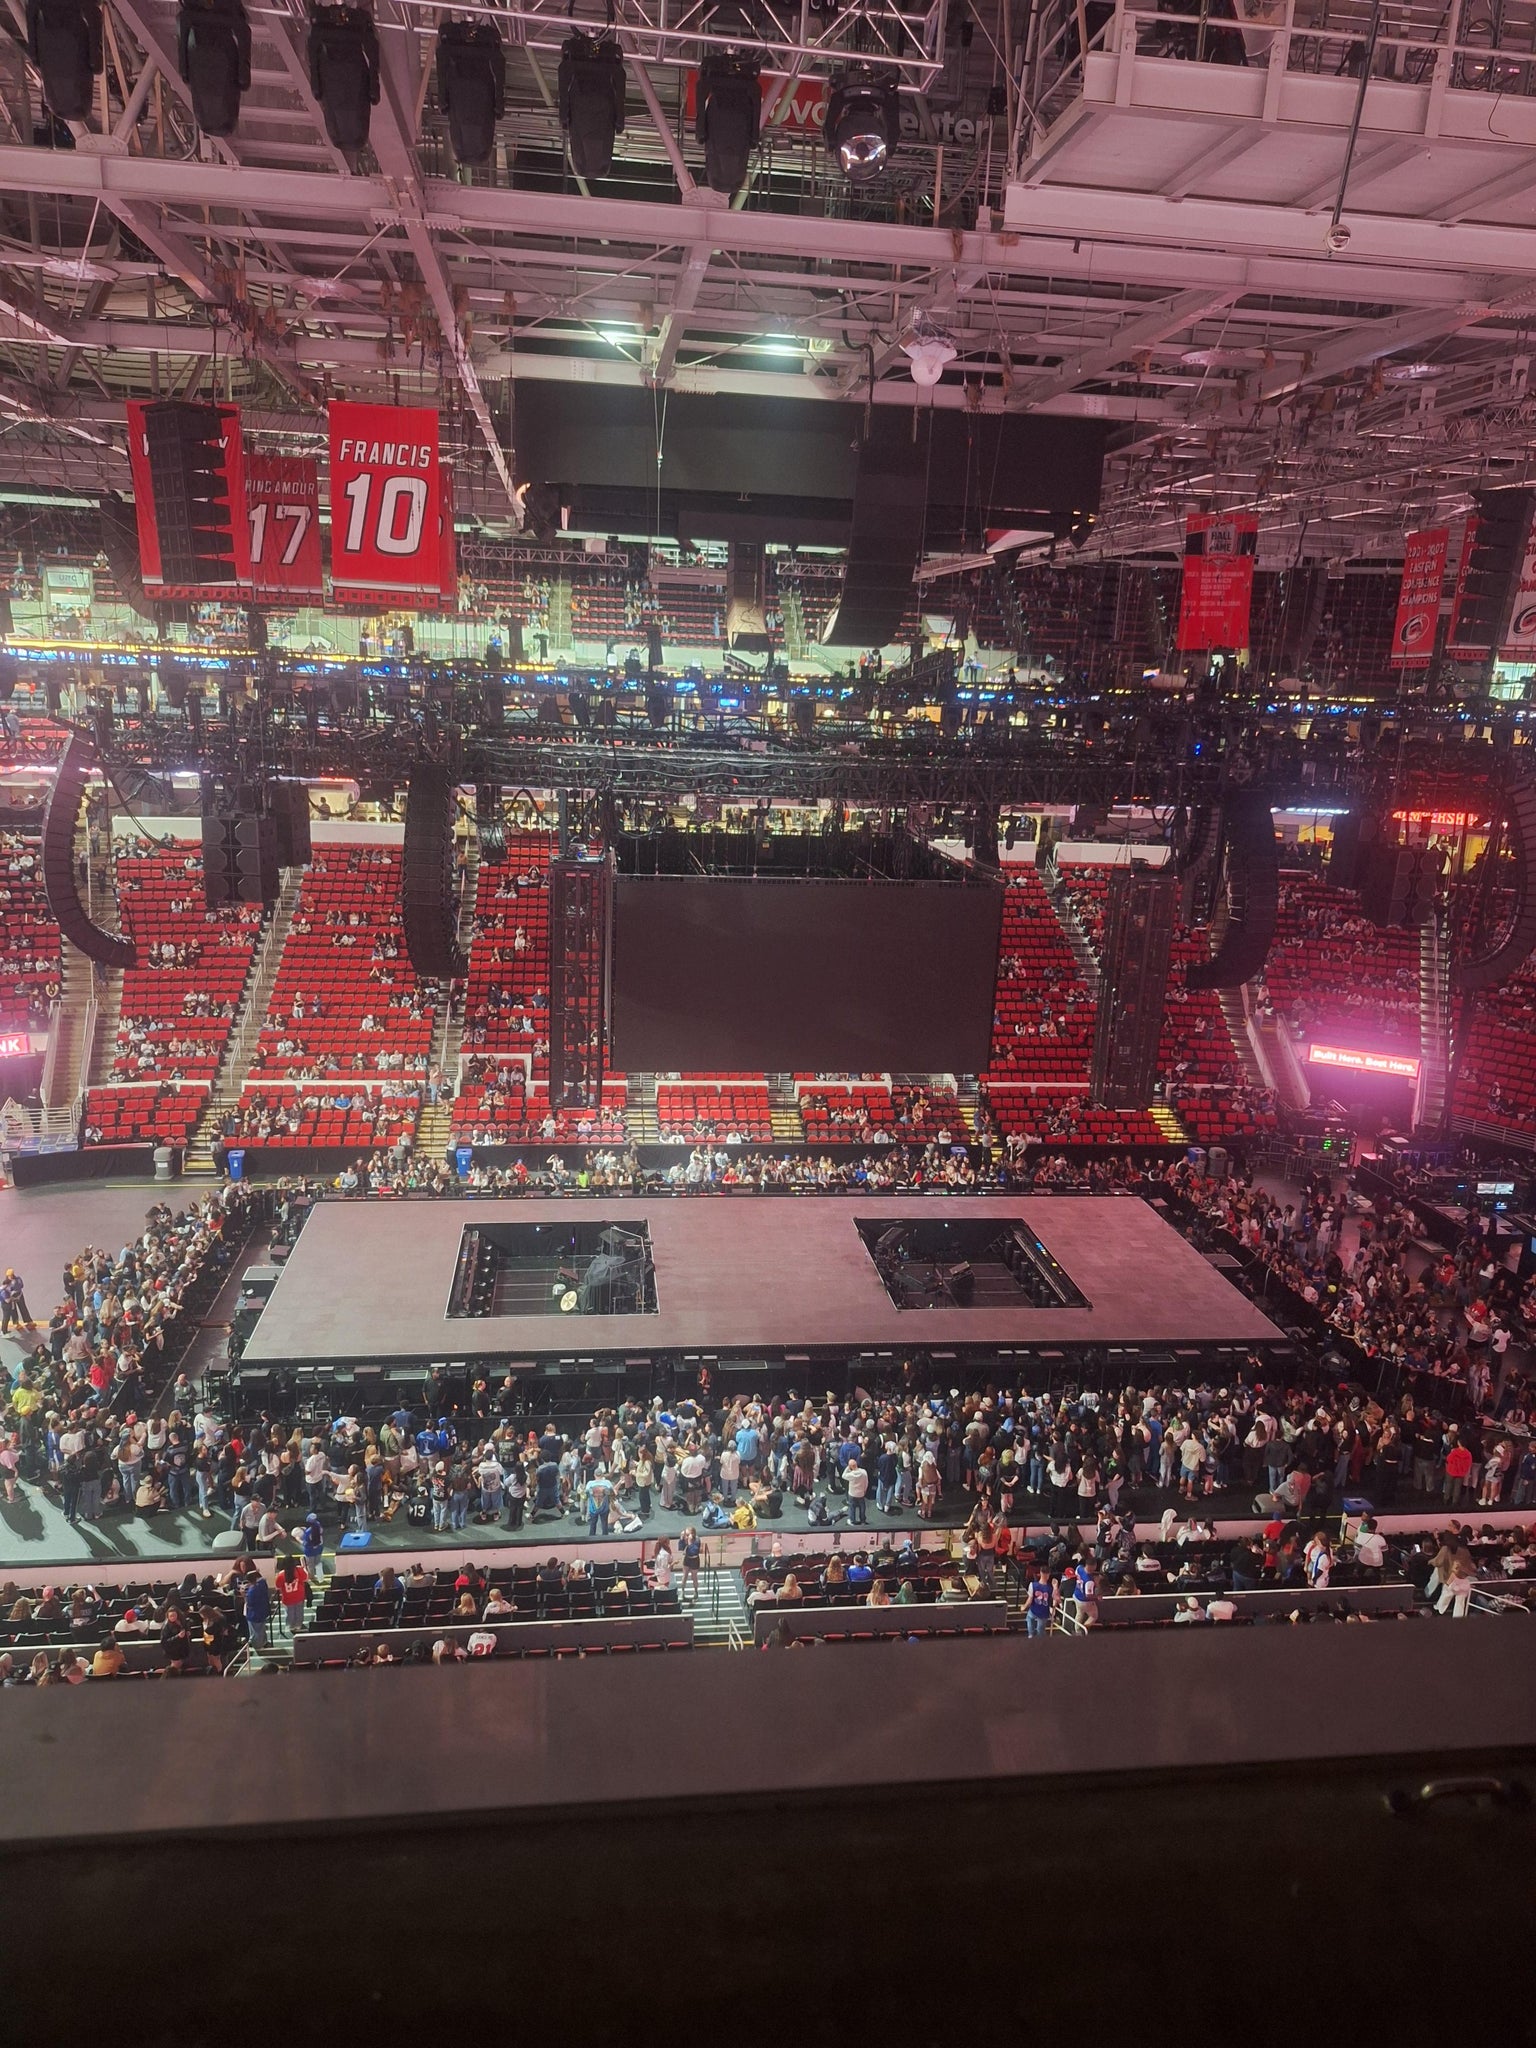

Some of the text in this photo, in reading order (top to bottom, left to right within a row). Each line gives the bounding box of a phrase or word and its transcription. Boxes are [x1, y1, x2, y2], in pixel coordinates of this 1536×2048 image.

[899, 109, 989, 143] enter
[340, 439, 431, 468] FRANCIS
[344, 473, 428, 554] 10
[249, 504, 311, 564] 17
[414, 1504, 426, 1517] 13
